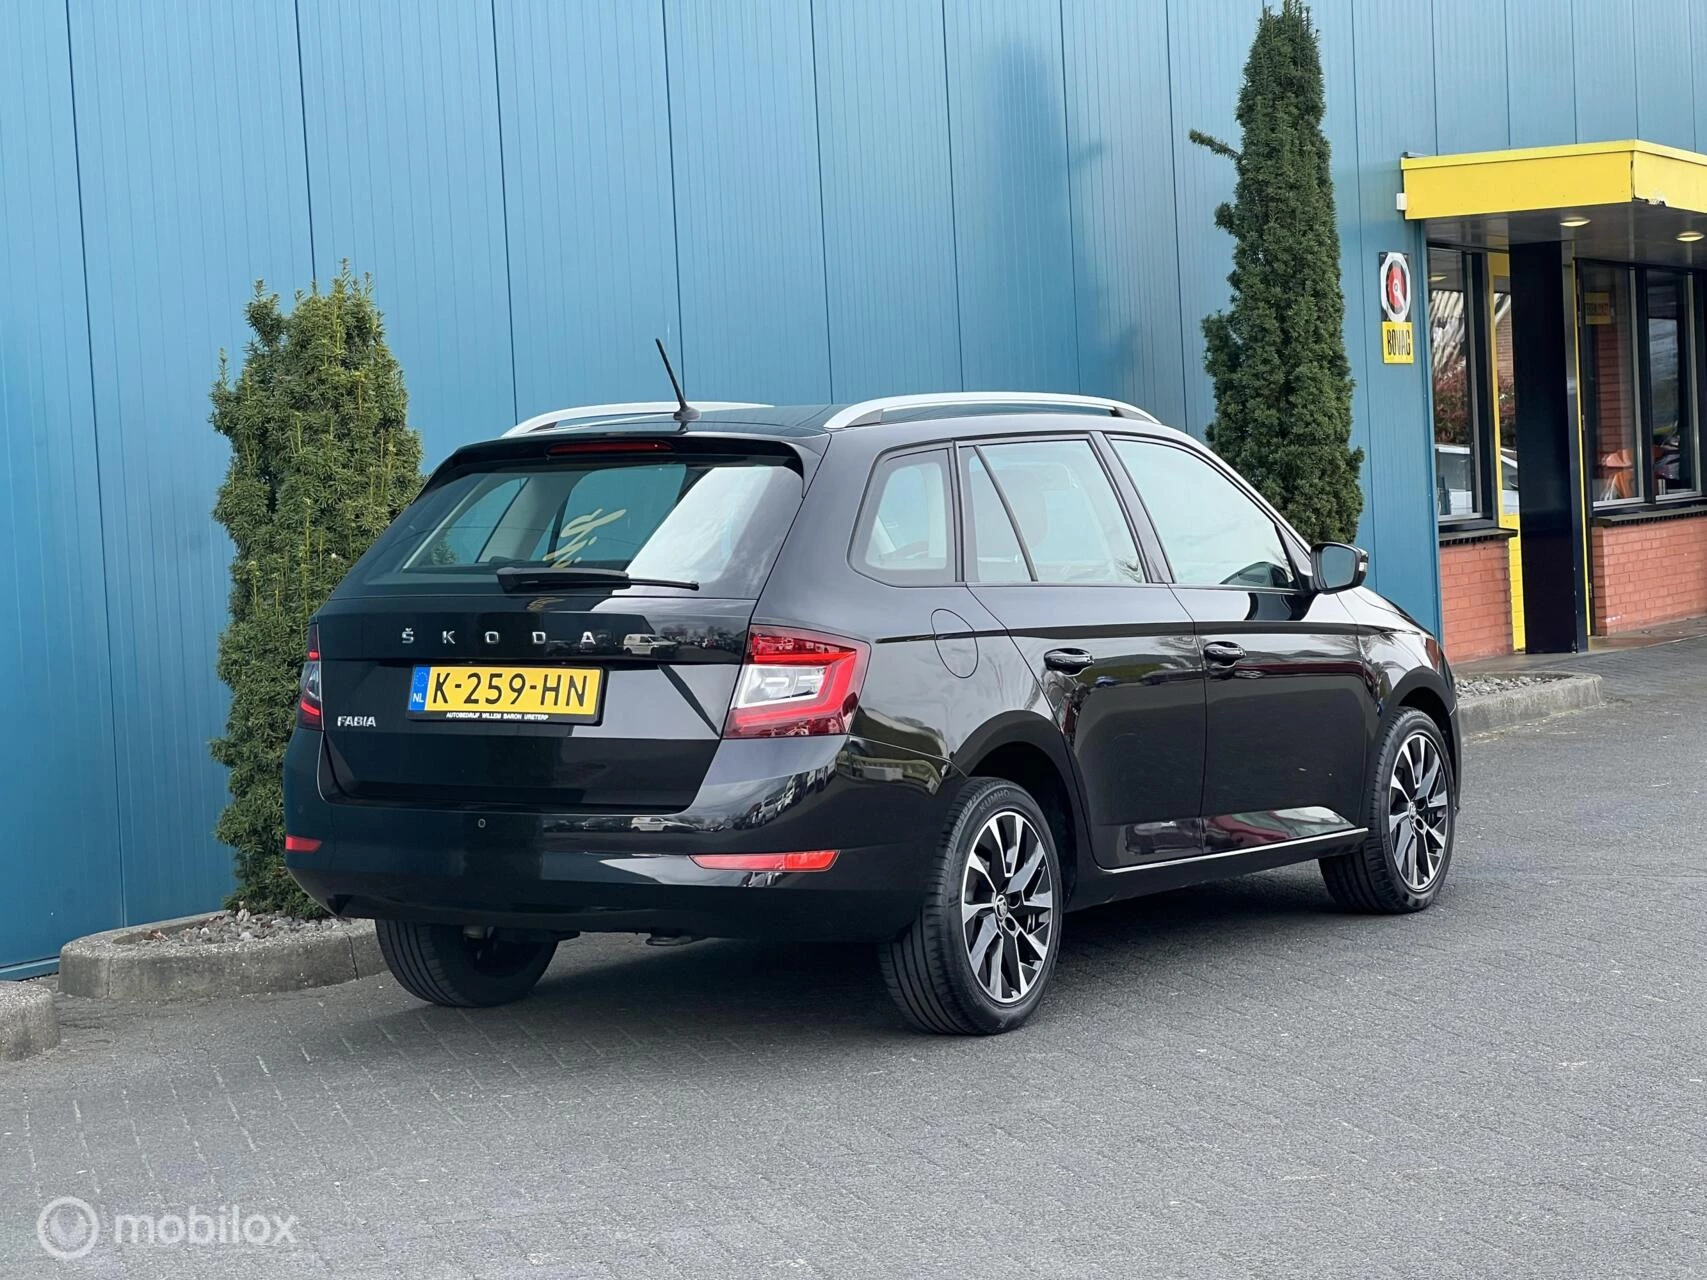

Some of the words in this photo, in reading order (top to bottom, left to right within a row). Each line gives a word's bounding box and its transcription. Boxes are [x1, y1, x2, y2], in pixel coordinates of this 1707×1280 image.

[1387, 329, 1411, 356] BOVAG
[412, 693, 425, 703] NL
[433, 672, 588, 707] K-259-HN
[337, 715, 376, 727] FABIA
[979, 789, 1010, 813] KUMHO
